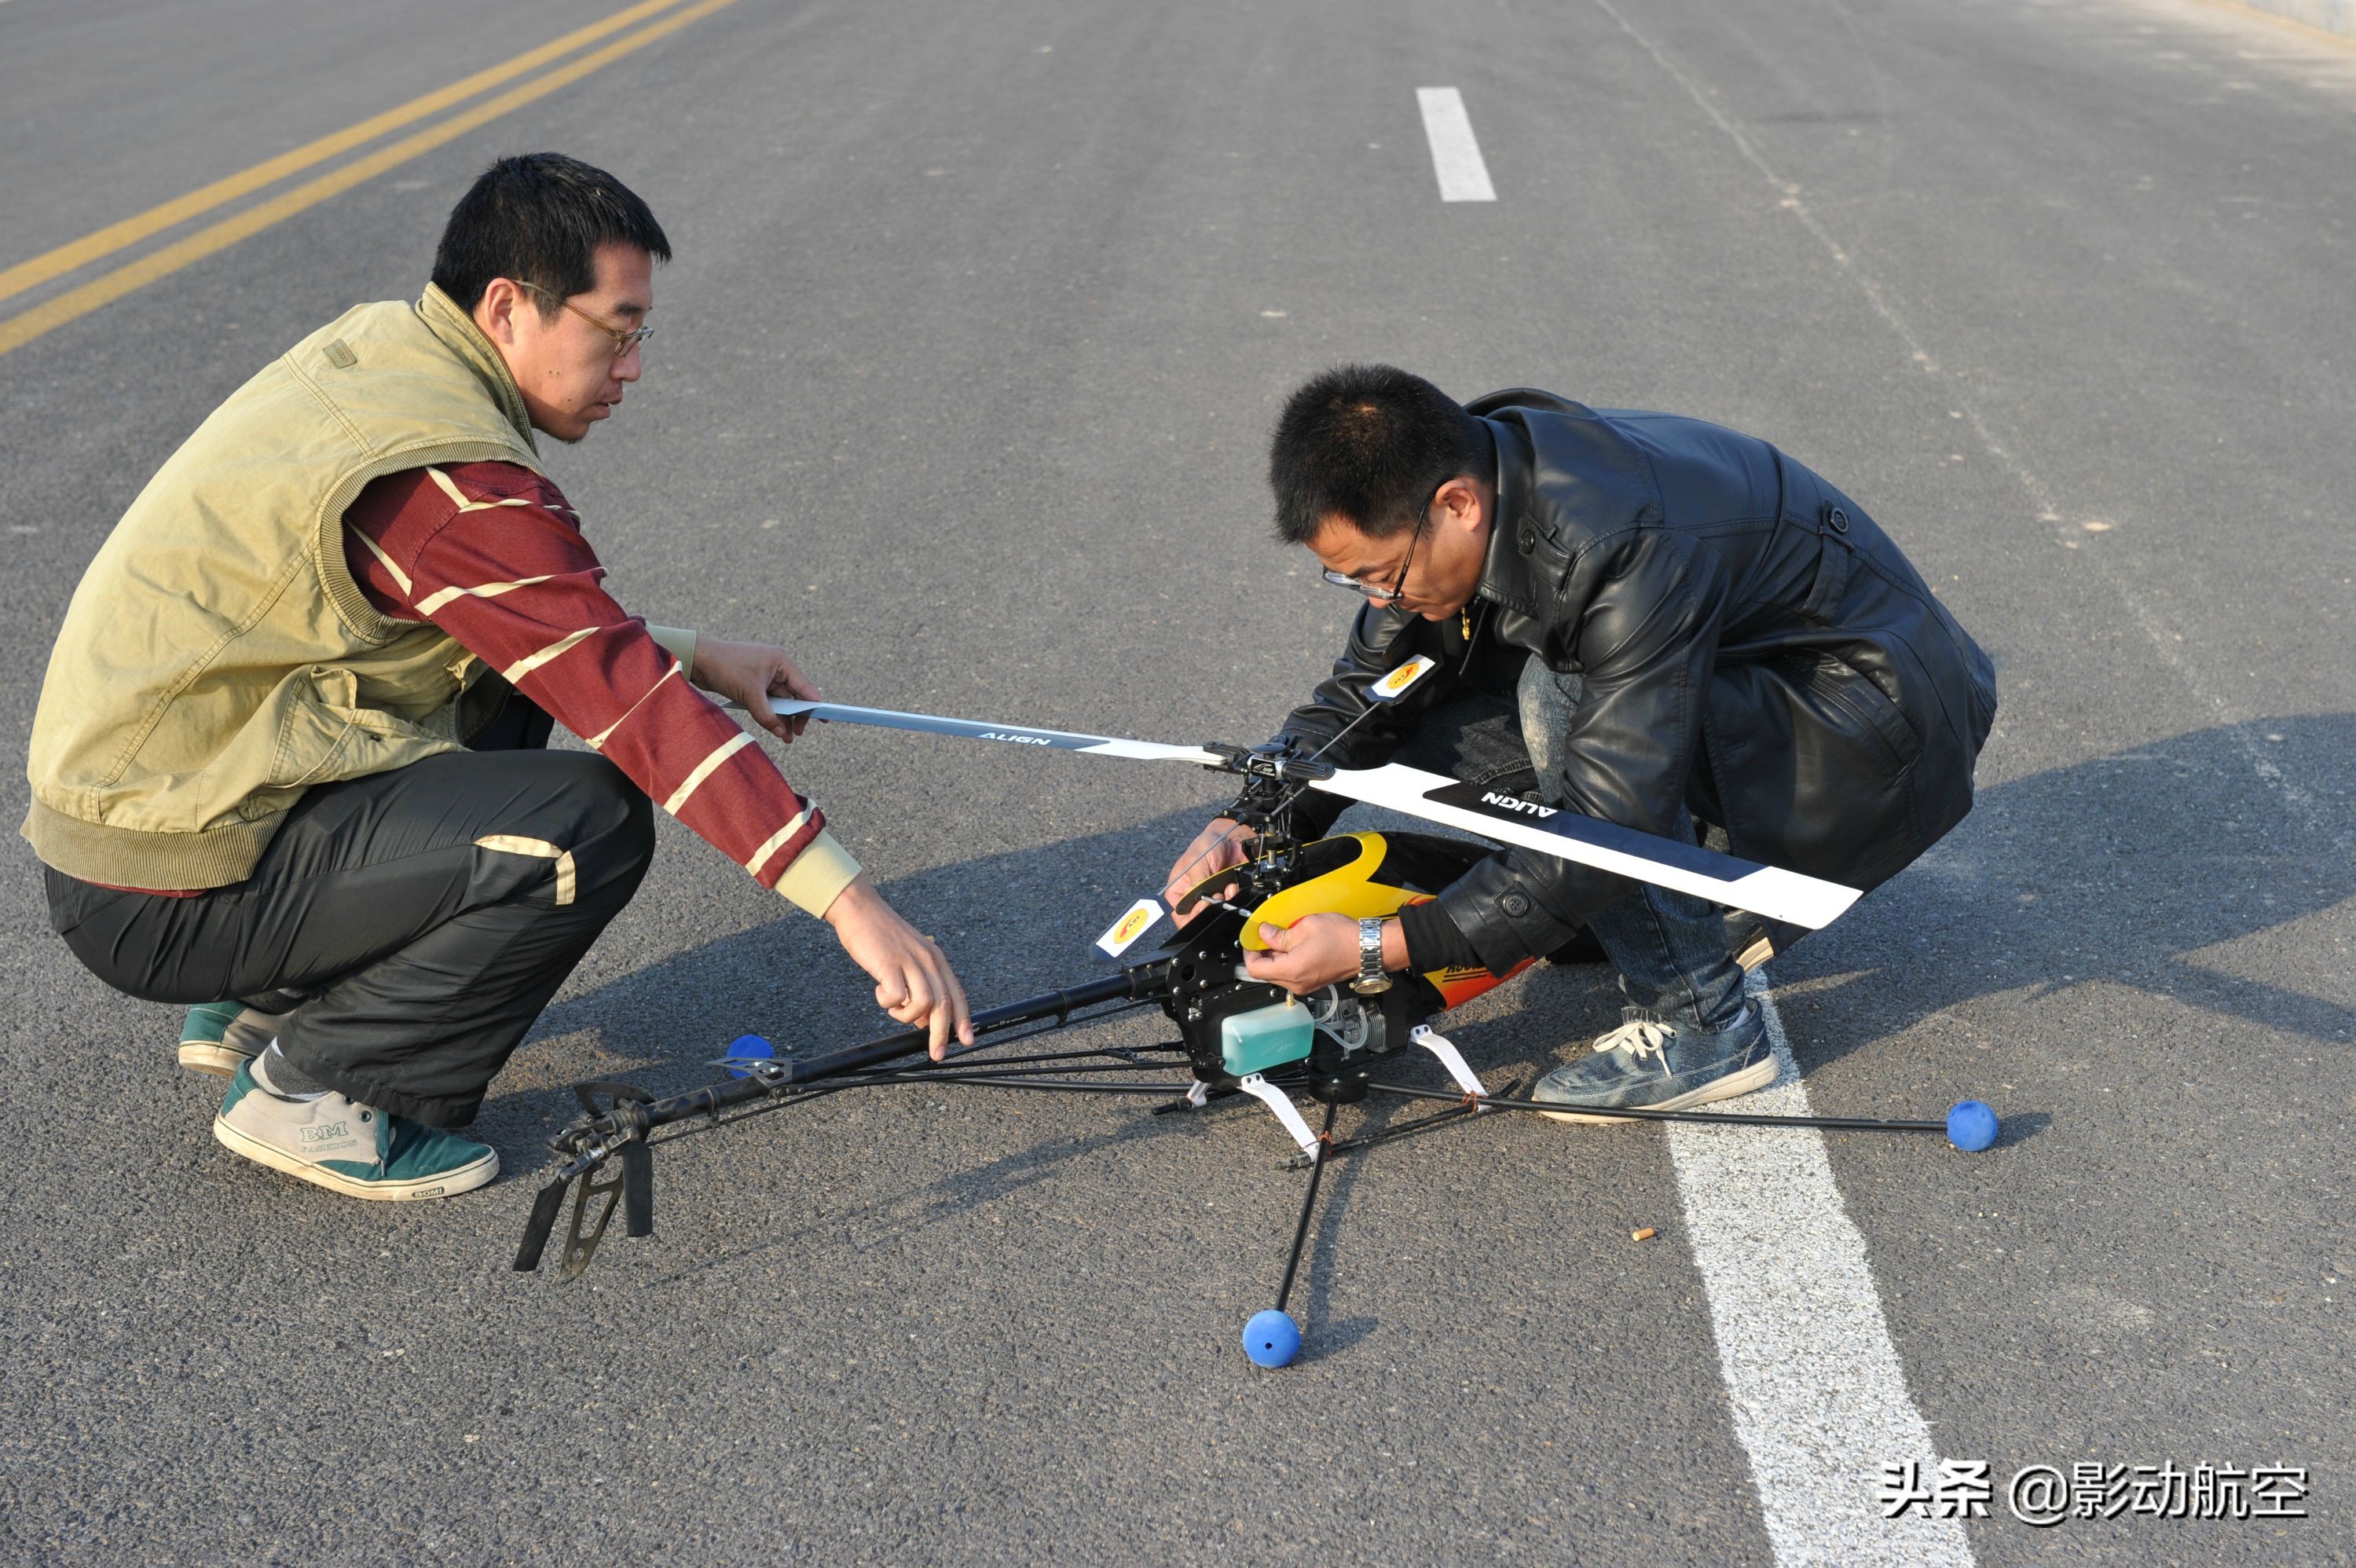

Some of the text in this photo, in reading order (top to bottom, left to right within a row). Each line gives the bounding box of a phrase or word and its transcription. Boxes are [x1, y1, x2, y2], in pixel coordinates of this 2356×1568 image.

[977, 732, 1052, 746] ALIGN
[1481, 792, 1558, 818] ALIGN
[300, 1121, 349, 1142] BM
[300, 1139, 357, 1153] FASHION
[415, 1187, 443, 1197] BOMI
